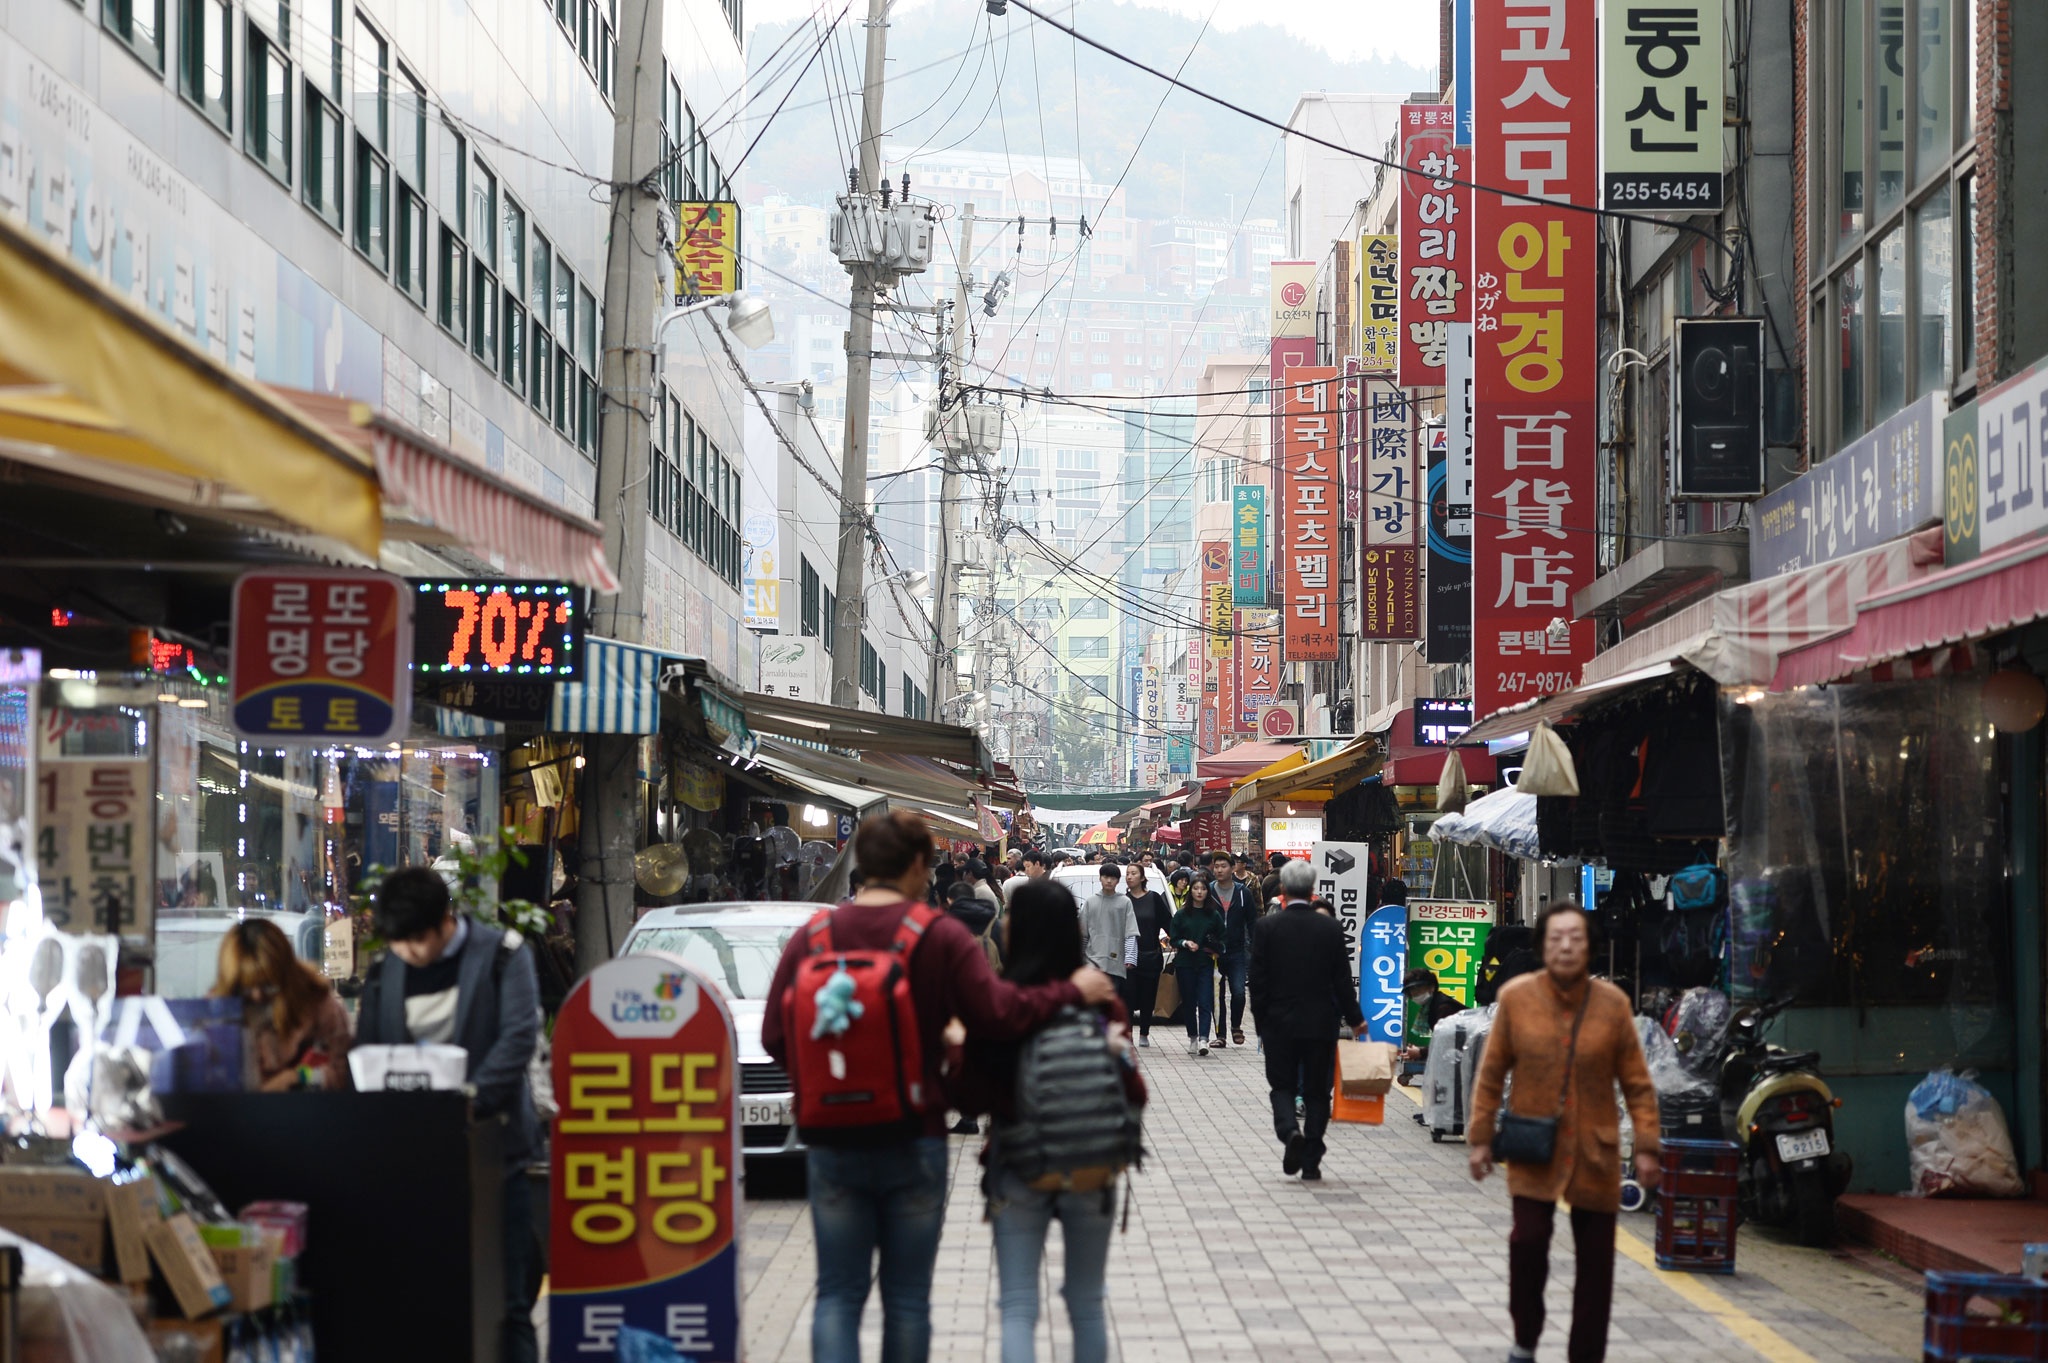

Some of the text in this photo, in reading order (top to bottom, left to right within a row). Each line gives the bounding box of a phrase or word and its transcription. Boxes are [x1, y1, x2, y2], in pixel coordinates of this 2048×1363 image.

[1624, 8, 1708, 153] 동산
[1613, 183, 1710, 200] 255-5454
[1275, 310, 1312, 320] LG전자
[1477, 272, 1501, 333] めがね
[1498, 221, 1571, 393] 안경
[1293, 379, 1329, 628] 대국스포츠벨리
[1494, 410, 1574, 608] 百貨店
[1801, 440, 1883, 566] 가방나라
[266, 583, 371, 625] 로또
[1386, 568, 1395, 634] LANCEL
[444, 590, 554, 668] 70%
[1300, 633, 1335, 648] 대국사
[266, 628, 371, 678] 명당
[1188, 641, 1200, 687] 챔피언
[1288, 651, 1336, 660] TEL:245-8955
[1498, 672, 1573, 692] 247-9876
[268, 697, 361, 732] 토토
[1146, 764, 1159, 785] 식당
[1271, 820, 1319, 831] GM Music
[1418, 905, 1476, 919] 안경도매
[1419, 926, 1476, 946] 코스모
[611, 1003, 677, 1023] Lotto
[559, 1053, 726, 1133] 로또
[564, 1146, 726, 1245] 명당
[577, 1304, 714, 1353] 토토
